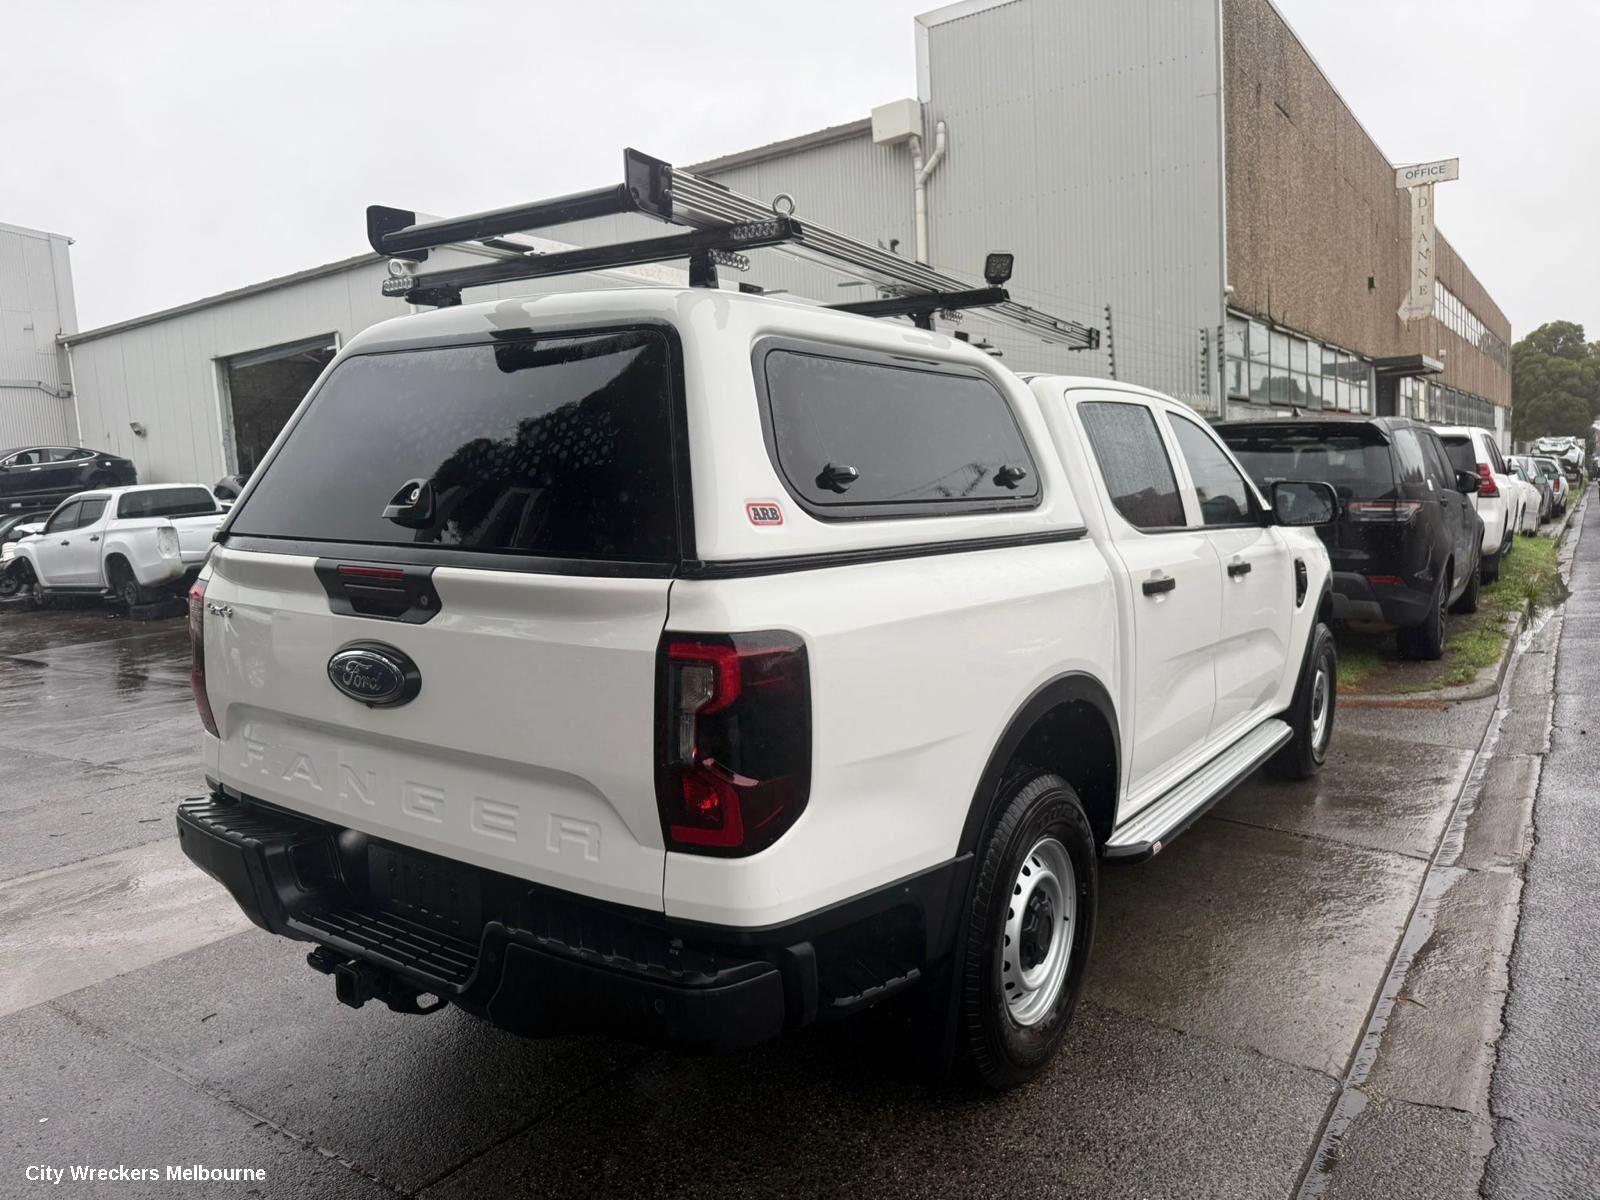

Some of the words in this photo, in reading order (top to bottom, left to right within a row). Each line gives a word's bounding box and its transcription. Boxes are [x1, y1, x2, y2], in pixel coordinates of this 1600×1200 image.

[1405, 164, 1446, 180] OFFICE
[1417, 197, 1429, 296] DIANNE
[752, 507, 780, 521] ARB
[342, 660, 383, 691] Ford
